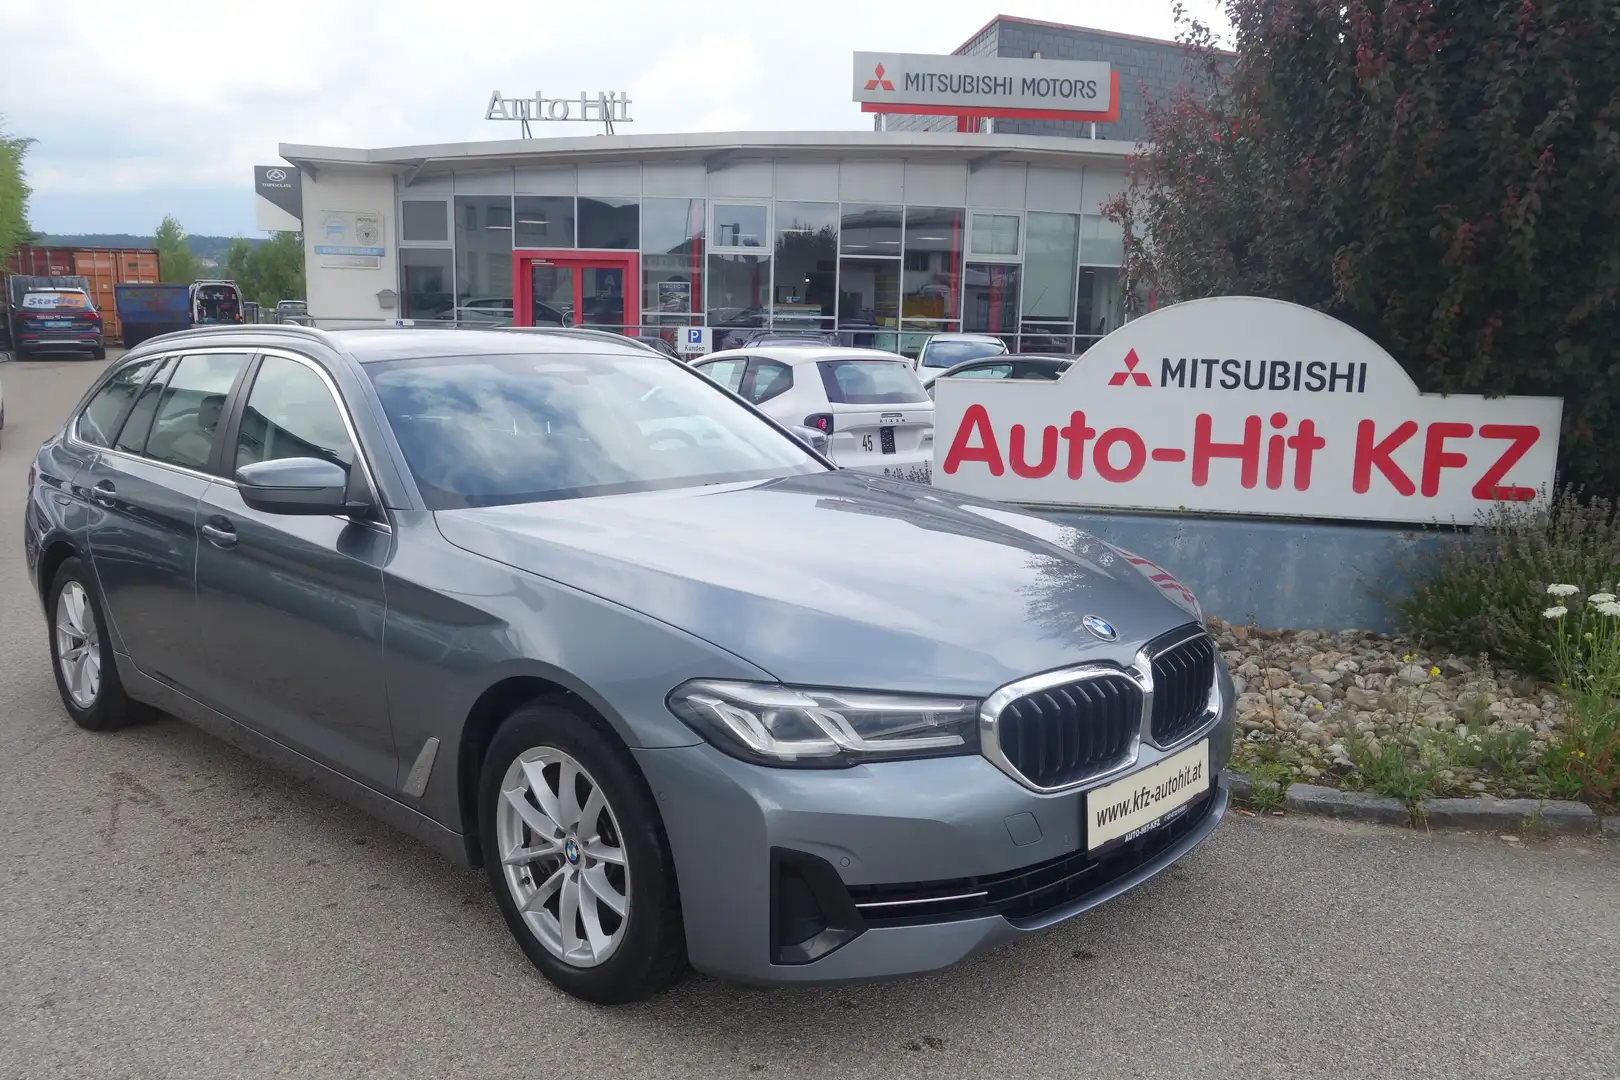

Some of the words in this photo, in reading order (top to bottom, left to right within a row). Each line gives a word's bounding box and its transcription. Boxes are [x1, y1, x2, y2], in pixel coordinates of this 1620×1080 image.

[904, 71, 1013, 96] MITSUBISHI
[1021, 77, 1097, 99] MOTORS
[485, 90, 570, 121] Auto
[580, 90, 633, 122] Hit
[28, 296, 81, 306] Stadler
[1160, 357, 1367, 393] MITSUBISHI
[862, 434, 873, 452] 45
[943, 403, 1326, 492] Auto-Hit
[1352, 418, 1541, 503] KFZ
[1096, 760, 1202, 828] www.kfz-autohit.at
